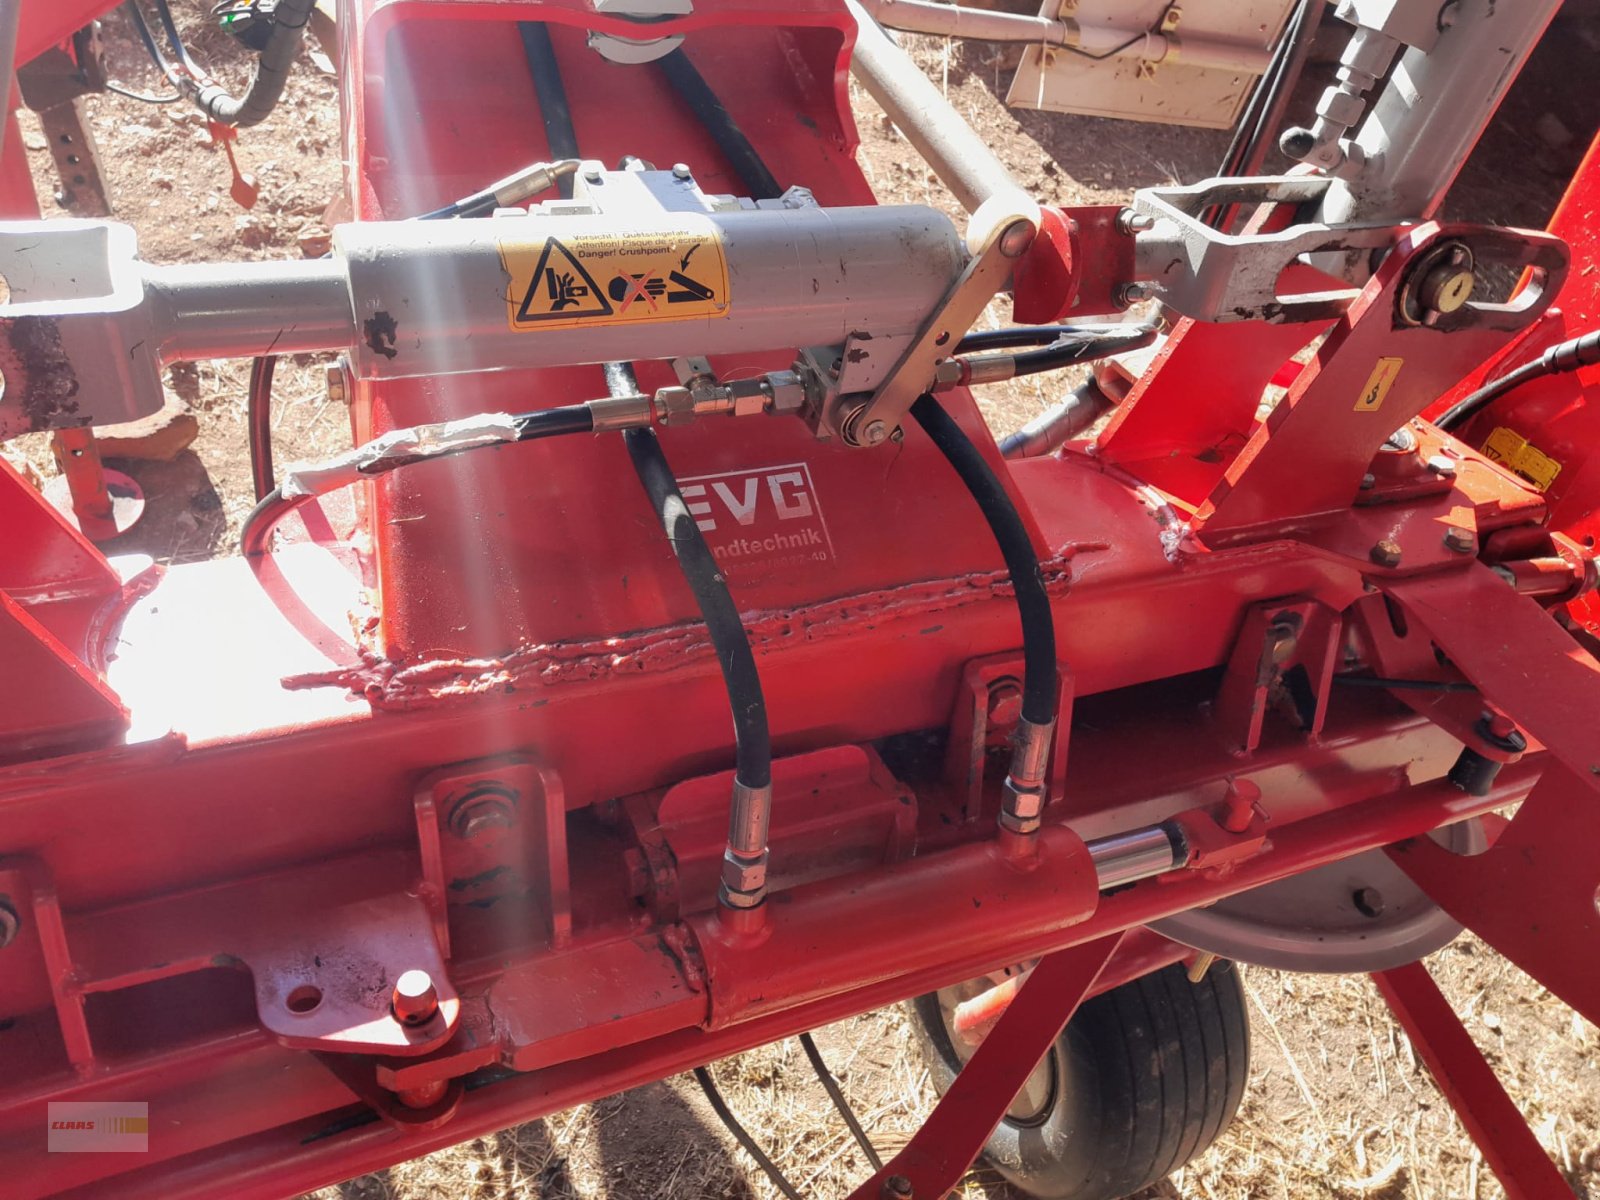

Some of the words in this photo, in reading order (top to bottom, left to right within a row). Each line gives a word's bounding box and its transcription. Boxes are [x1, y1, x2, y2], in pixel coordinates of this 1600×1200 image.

[576, 240, 620, 249] Attention!
[578, 249, 617, 259] Danger!
[619, 246, 671, 257] Crushpoint
[713, 528, 822, 559] ndtechnik
